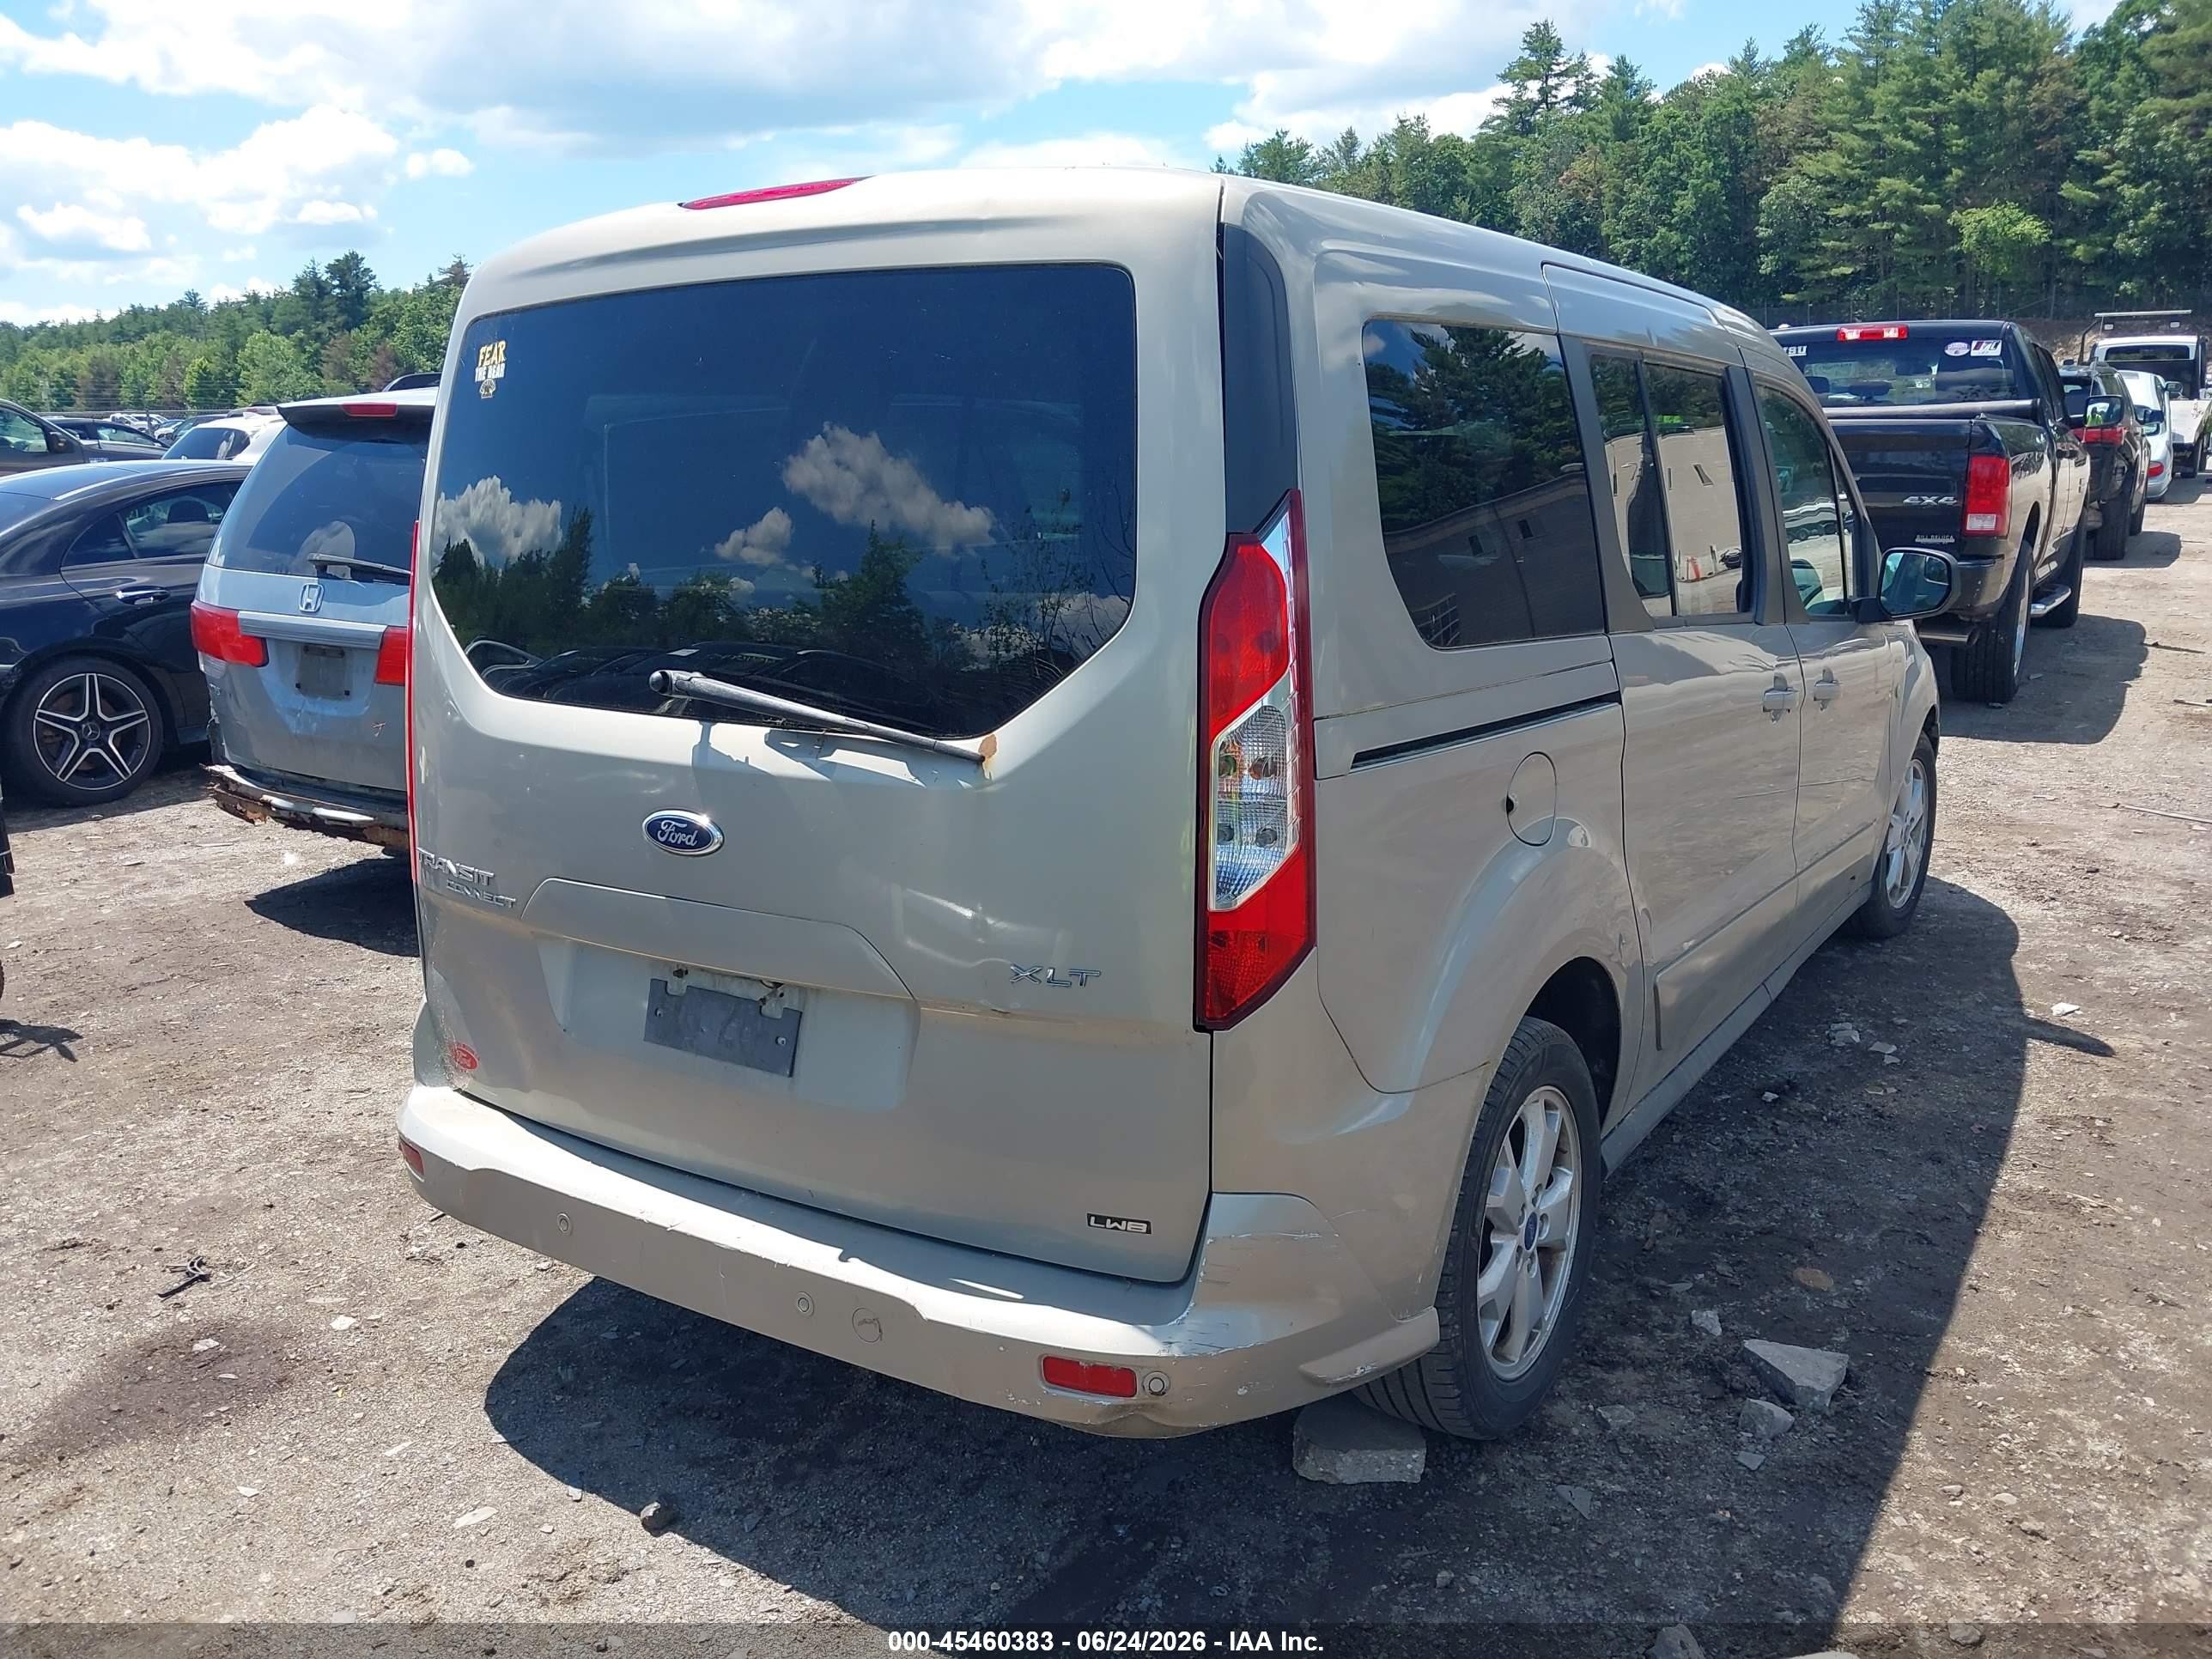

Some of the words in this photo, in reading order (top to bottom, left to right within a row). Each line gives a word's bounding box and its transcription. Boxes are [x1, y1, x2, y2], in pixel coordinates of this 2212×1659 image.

[478, 340, 507, 367] FEAR
[475, 365, 487, 382] THE
[487, 362, 506, 379] BEAR
[657, 819, 699, 847] Ford
[416, 847, 495, 886] TRANSIT
[446, 878, 516, 908] CONNECT
[1009, 963, 1102, 988] XLT
[1090, 1216, 1148, 1232] LWB
